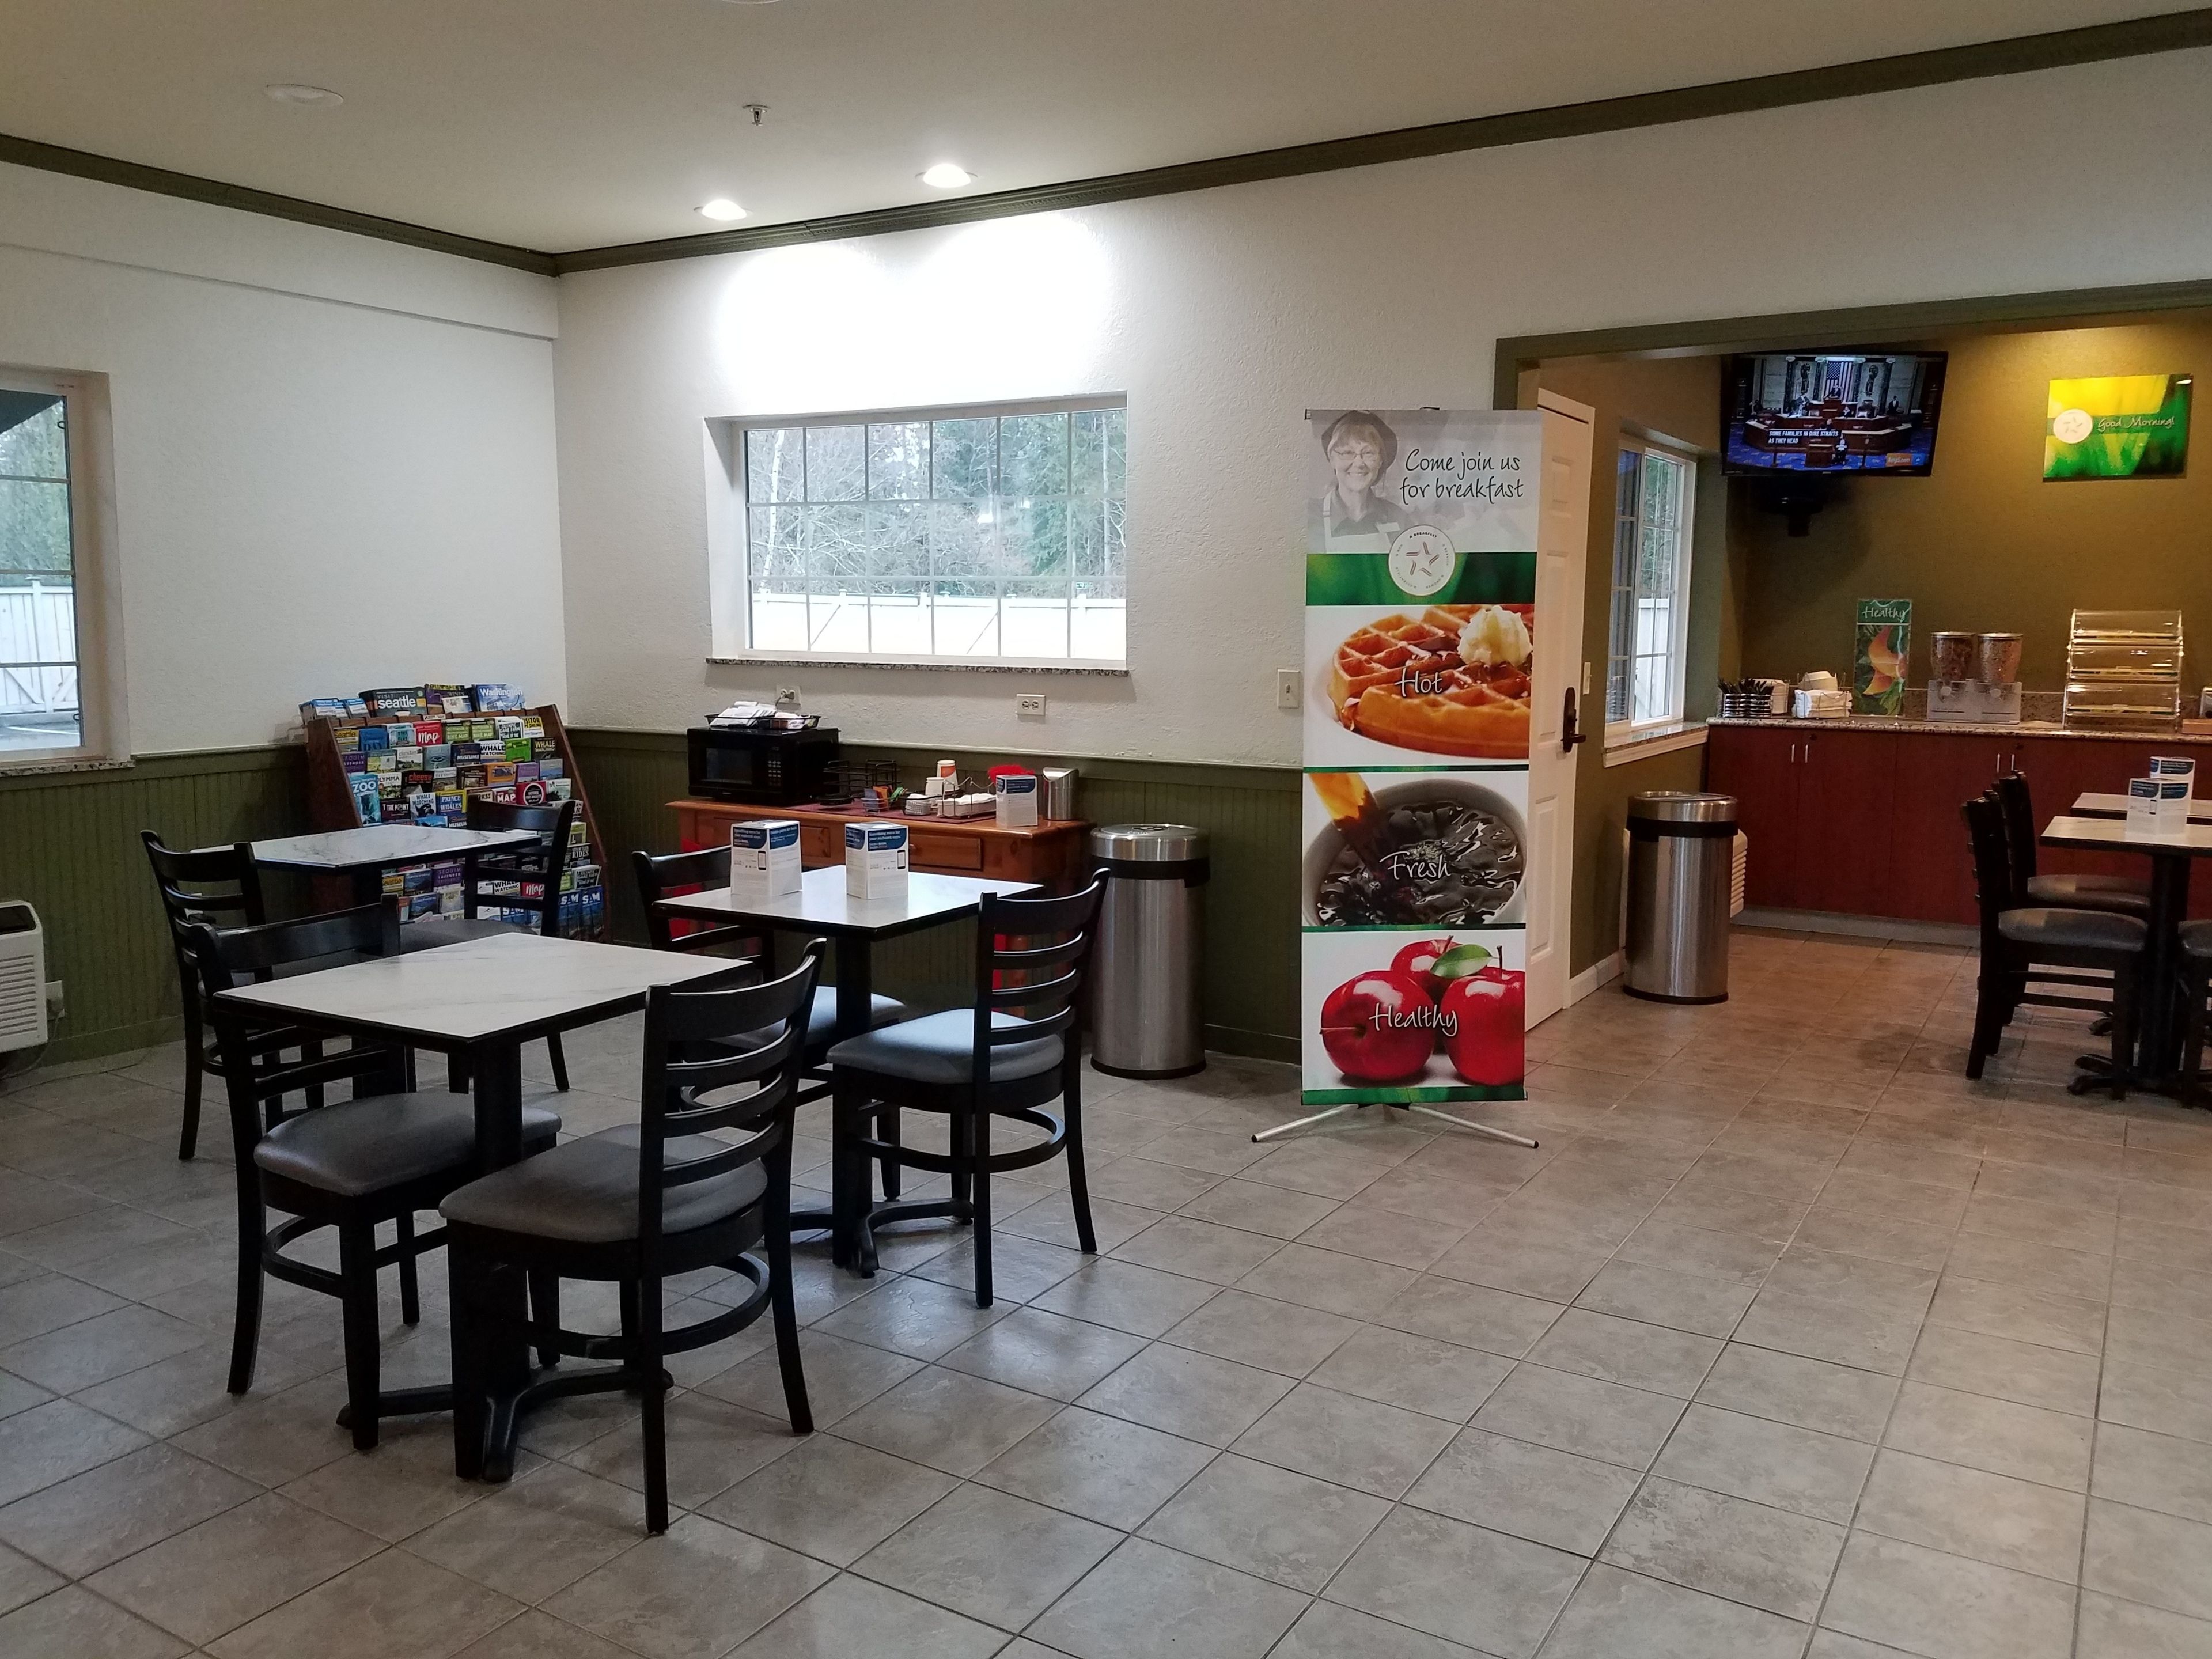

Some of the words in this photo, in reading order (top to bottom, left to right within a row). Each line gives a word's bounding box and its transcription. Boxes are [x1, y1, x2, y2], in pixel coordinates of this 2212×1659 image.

[2097, 417, 2122, 433] Good
[2124, 416, 2175, 429] Morning!
[1406, 449, 1456, 472] Come
[1457, 452, 1495, 480] join
[1501, 457, 1521, 471] us
[1400, 477, 1430, 505] for
[1435, 475, 1524, 505] breakfast
[1861, 605, 1906, 622] Healthy
[1393, 668, 1443, 698] Hot
[479, 687, 524, 698] Washington
[378, 694, 416, 709] seattle
[418, 732, 440, 744] Map
[408, 772, 433, 781] cheese
[352, 781, 377, 793] ZOO
[497, 793, 516, 803] MAP
[1379, 850, 1452, 880] Fresh
[525, 884, 544, 895] Map
[1368, 1002, 1458, 1037] Healthy
